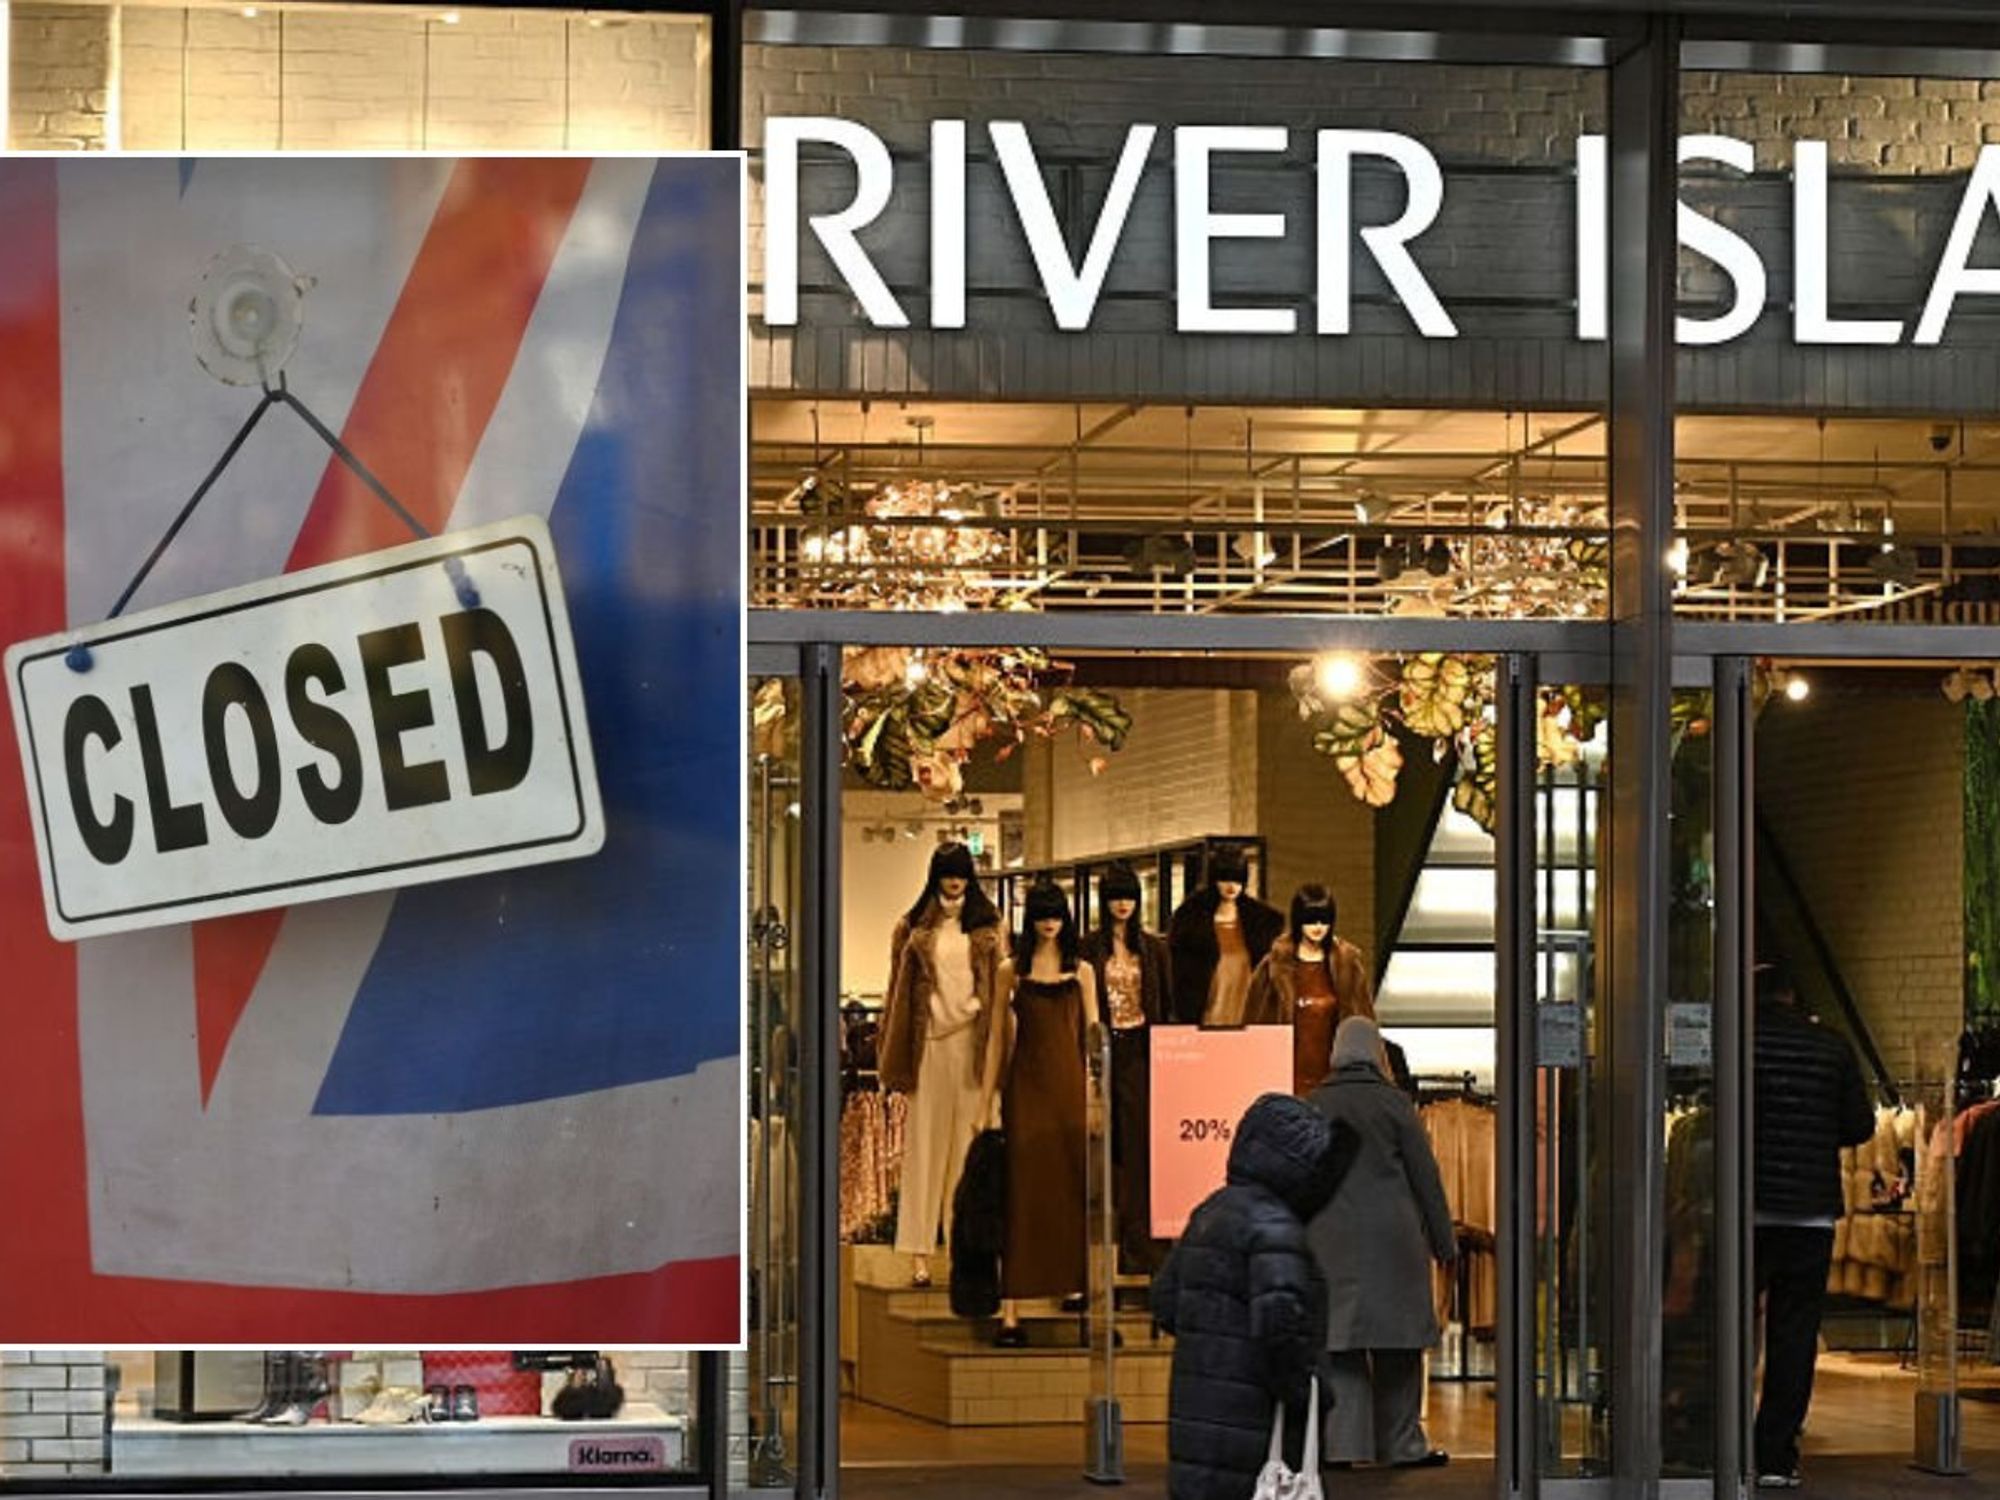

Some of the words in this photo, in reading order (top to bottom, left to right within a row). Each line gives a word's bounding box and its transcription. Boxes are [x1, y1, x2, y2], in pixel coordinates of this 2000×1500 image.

[762, 116, 1459, 337] RIVER
[63, 607, 534, 865] CLOSED
[1180, 1119, 1231, 1141] 20%
